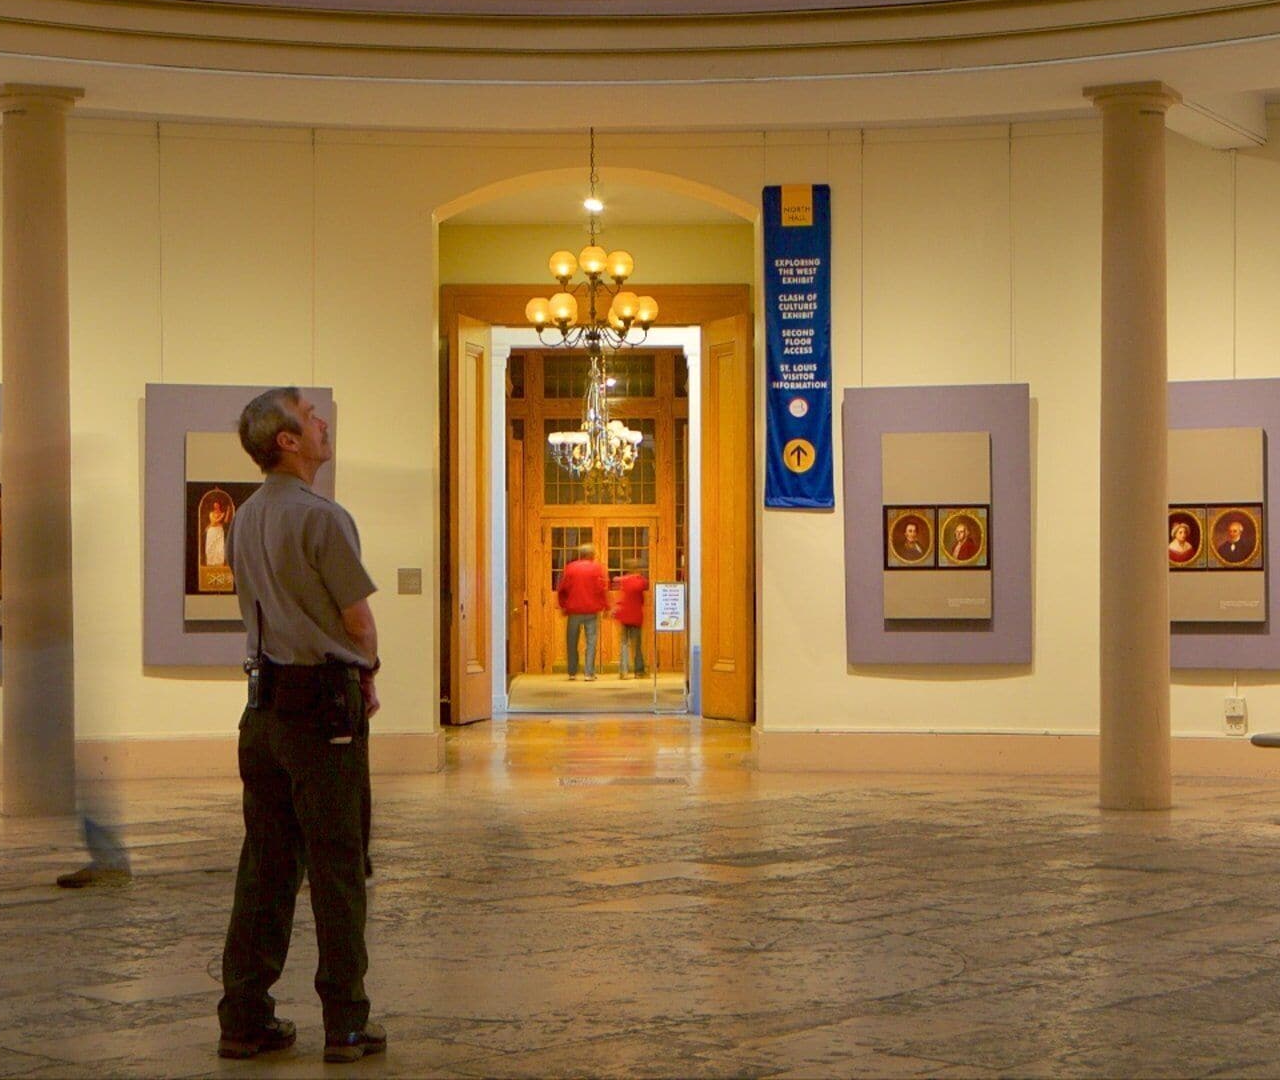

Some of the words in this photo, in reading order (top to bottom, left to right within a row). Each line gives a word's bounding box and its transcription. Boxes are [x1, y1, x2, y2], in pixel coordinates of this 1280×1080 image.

[775, 258, 820, 267] EXPLORING
[796, 267, 816, 275] WEST
[782, 276, 814, 284] EXHIBIT
[778, 294, 804, 302] CLASH
[807, 293, 817, 301] OF
[778, 302, 817, 311] CULTURES
[782, 311, 814, 320] EXHIBIT
[782, 329, 815, 337] SECOND
[783, 346, 813, 355] ACCESS
[780, 364, 790, 372] ST.
[793, 363, 817, 372] LOUIS
[782, 372, 815, 380] VISITOR
[772, 381, 827, 389] INFORMATION
